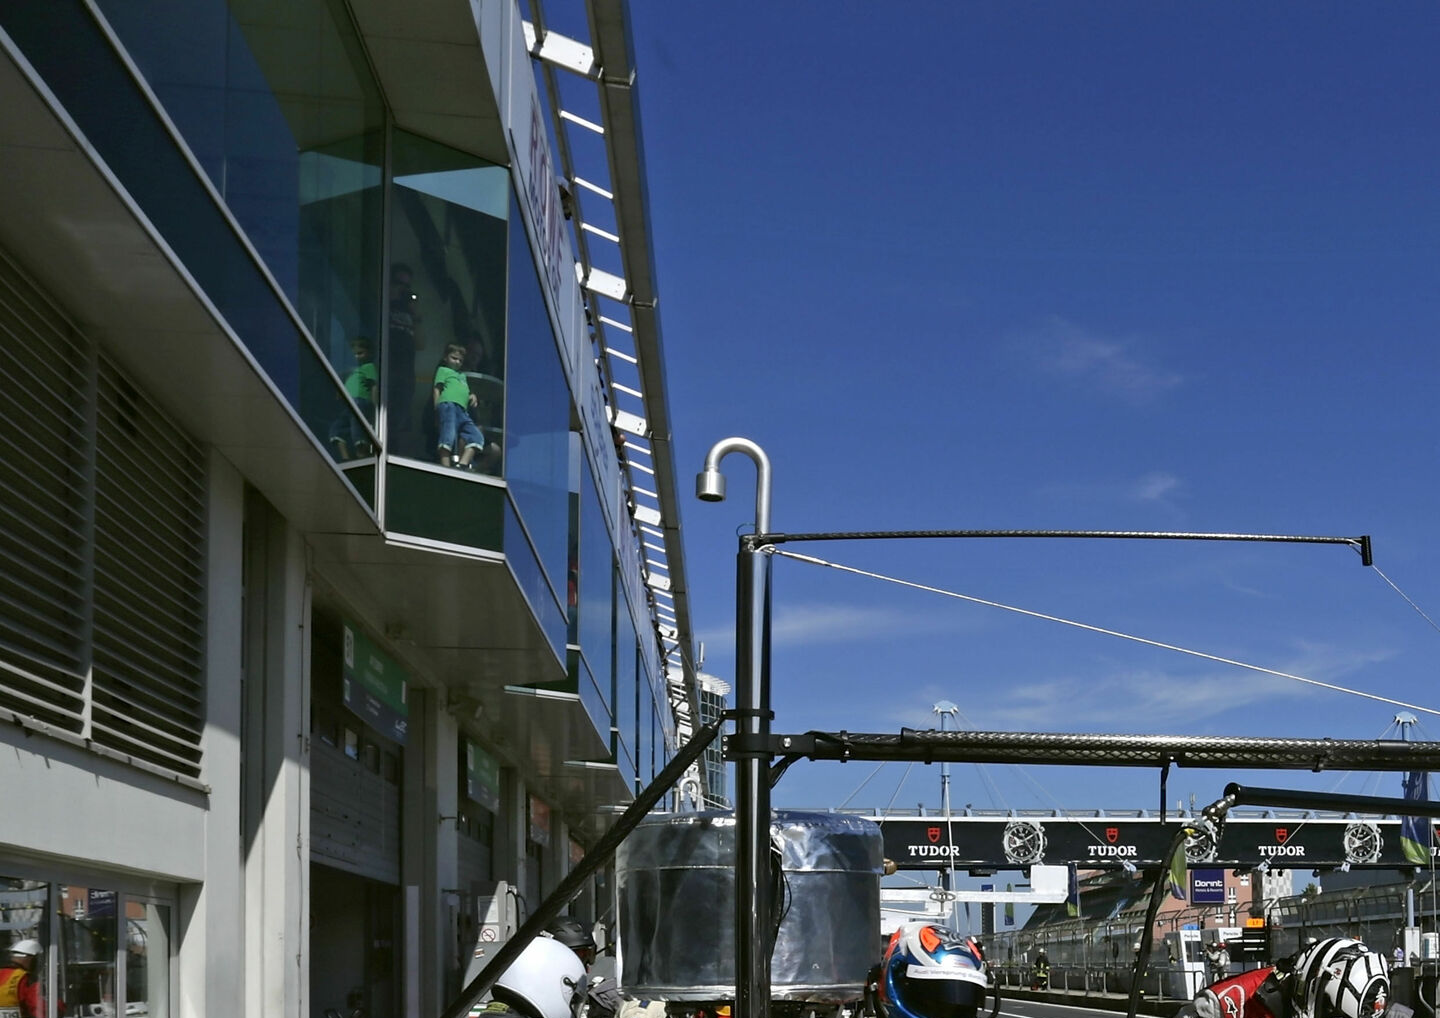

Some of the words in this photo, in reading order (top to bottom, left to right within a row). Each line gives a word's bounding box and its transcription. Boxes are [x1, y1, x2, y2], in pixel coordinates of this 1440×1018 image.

[908, 845, 960, 857] TUDOR
[1088, 845, 1137, 857] TUDOR
[1258, 845, 1305, 857] TUDOR
[1194, 879, 1223, 887] Dorint
